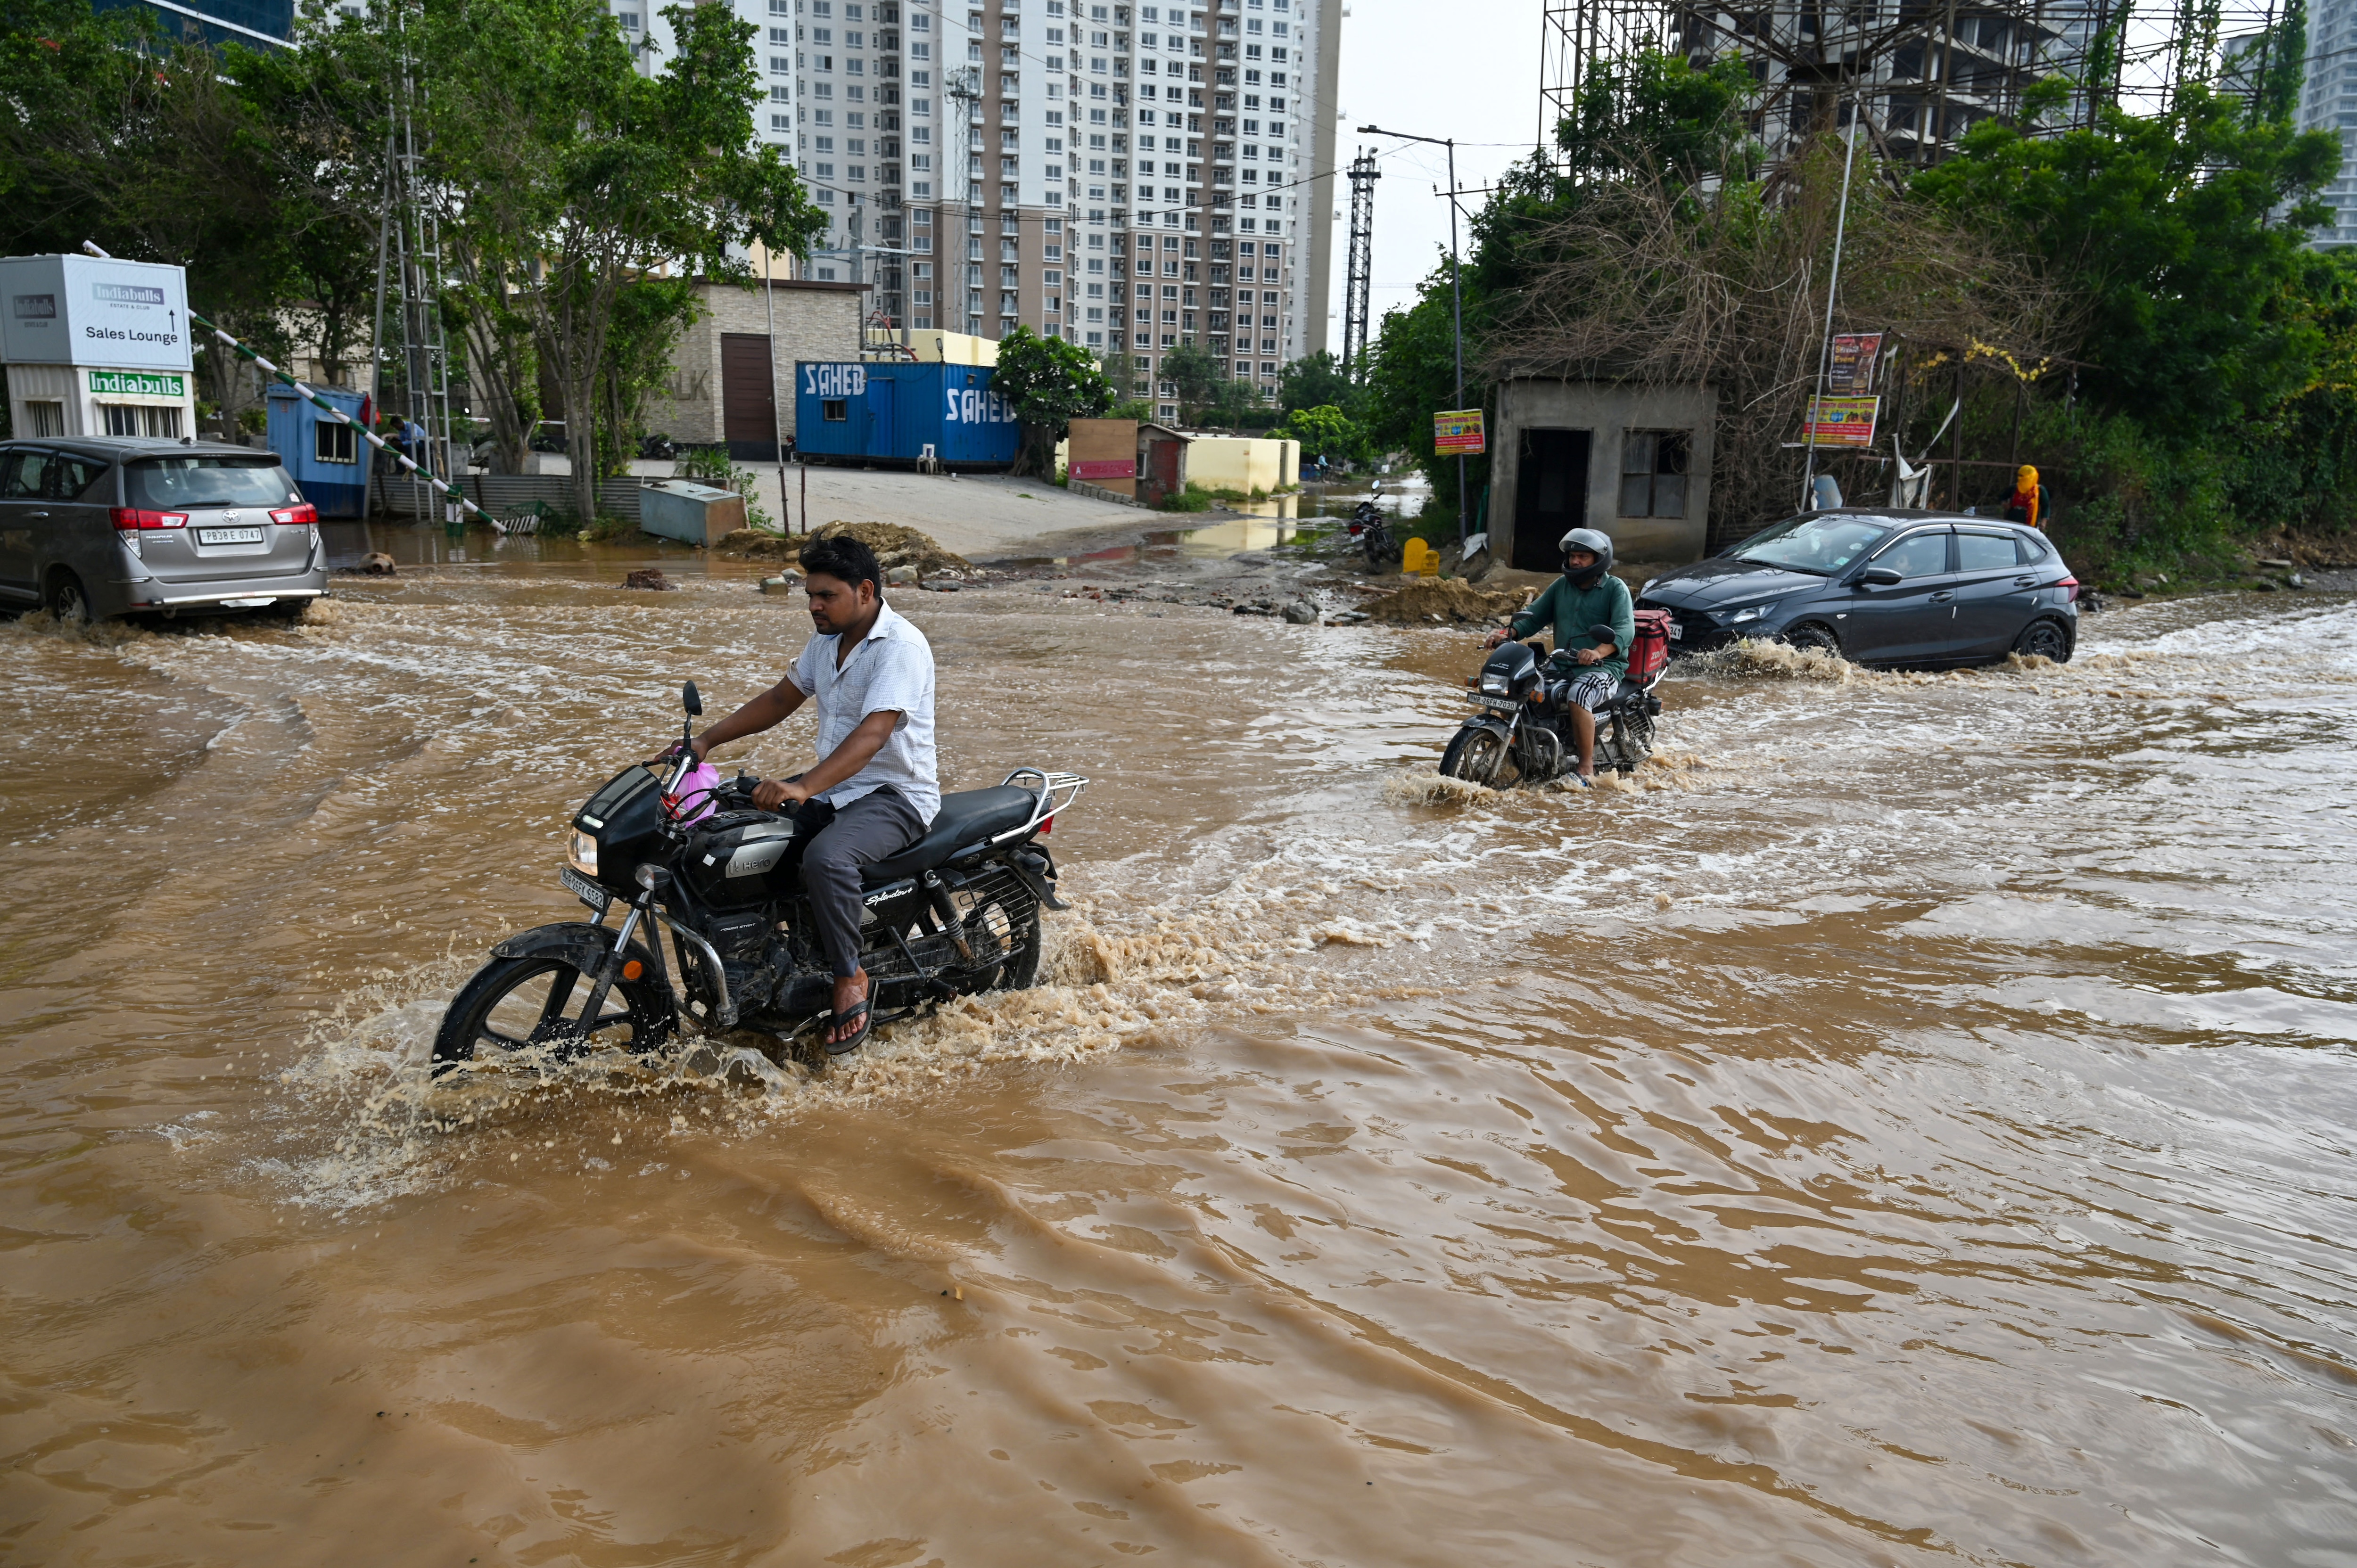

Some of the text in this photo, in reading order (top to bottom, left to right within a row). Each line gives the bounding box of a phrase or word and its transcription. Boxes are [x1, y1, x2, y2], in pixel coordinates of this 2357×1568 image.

[96, 286, 161, 303] Indiabulls
[15, 298, 54, 315] Indiabulls
[86, 326, 178, 346] Sales Lounge
[90, 371, 182, 395] Indiabulls
[805, 364, 865, 397] SAHEB
[946, 389, 1017, 424] SAHEB
[206, 530, 259, 541] PB38 E 0747
[1483, 698, 1497, 706] 26FH
[1499, 700, 1515, 709] 7030
[586, 887, 603, 908] 6582
